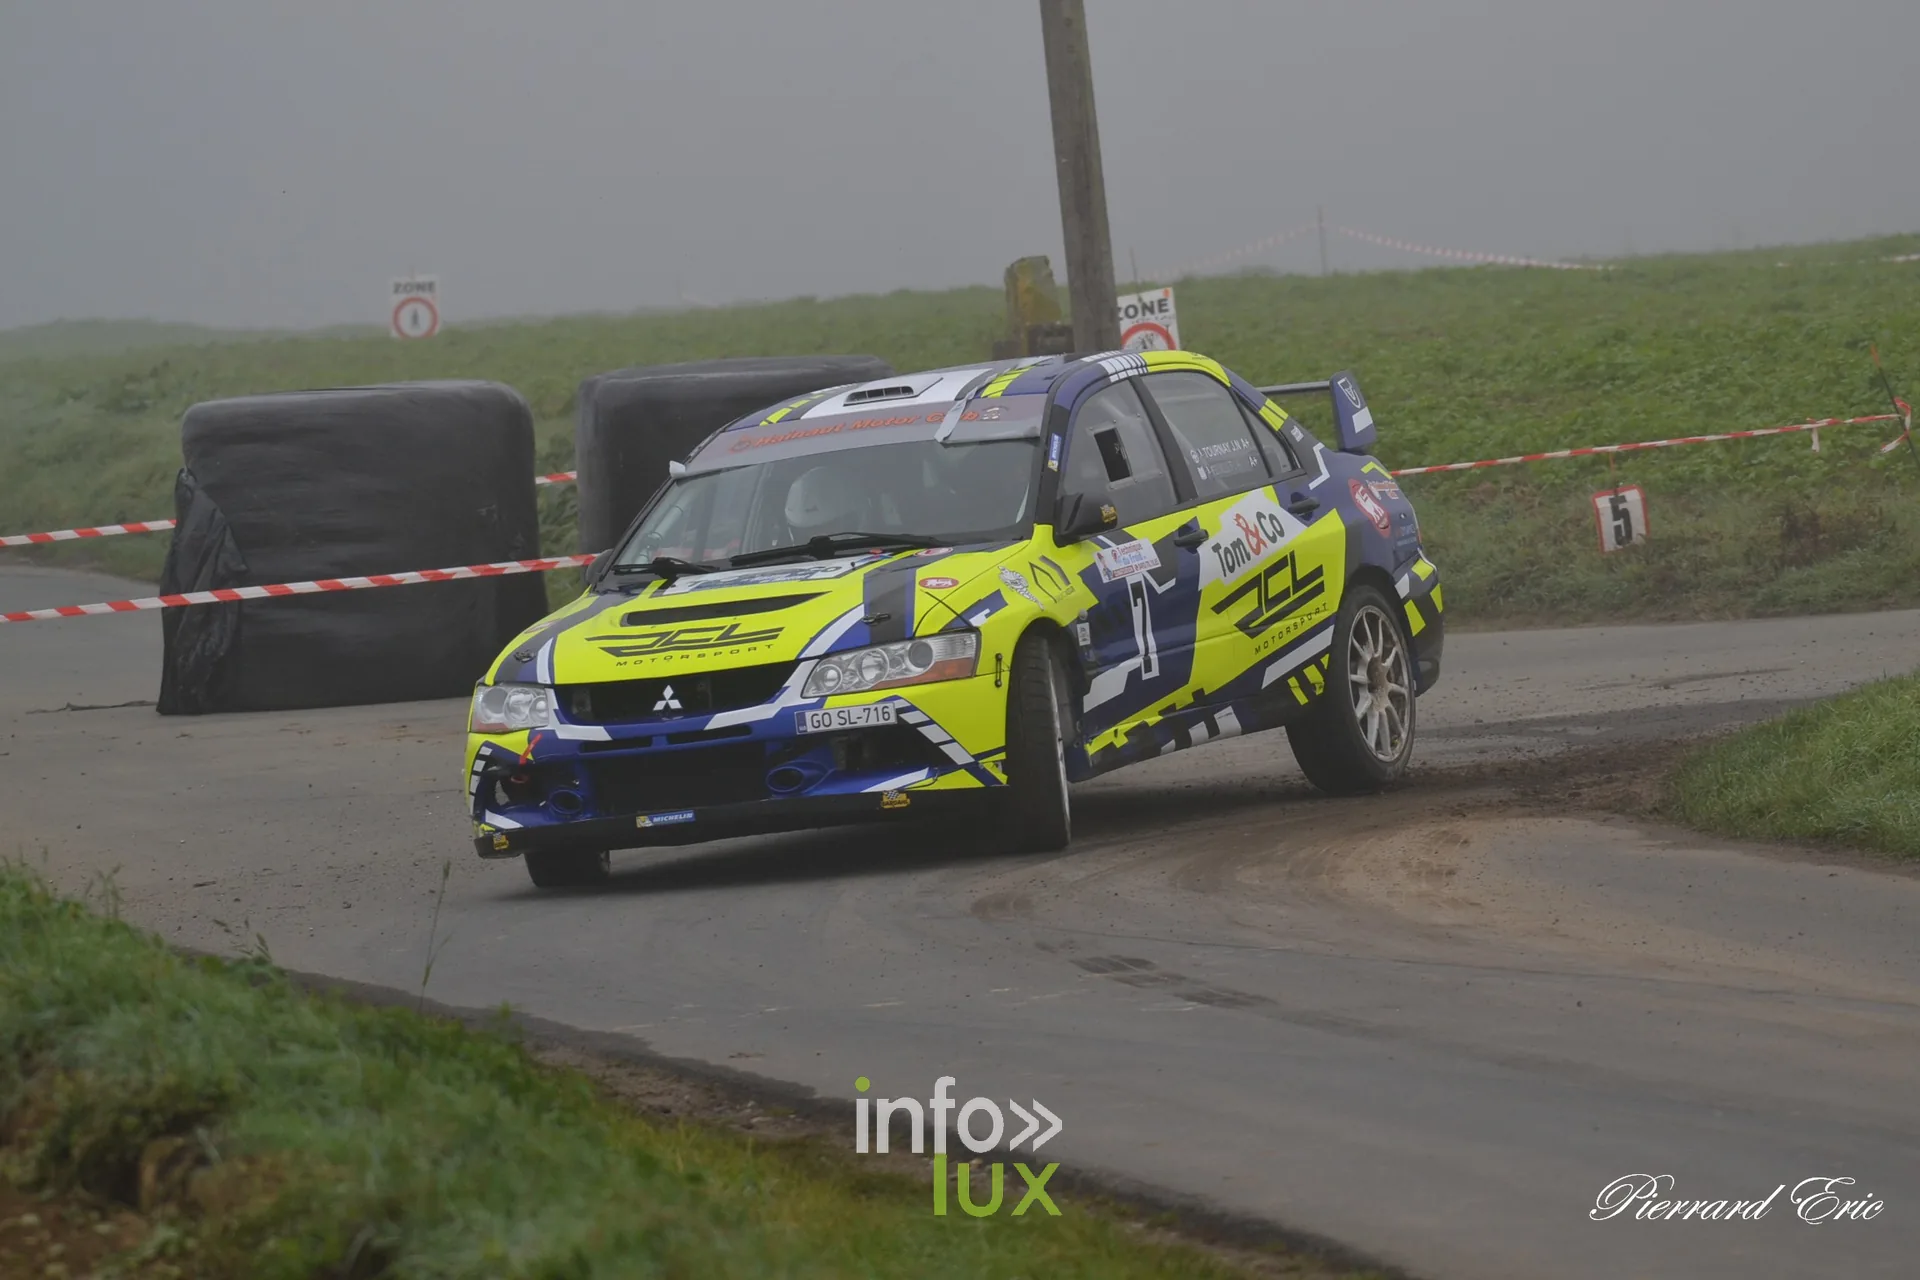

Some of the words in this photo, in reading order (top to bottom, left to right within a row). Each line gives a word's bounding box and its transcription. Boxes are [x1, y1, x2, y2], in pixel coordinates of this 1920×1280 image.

[393, 281, 436, 294] ZONE
[850, 414, 921, 430] Motor
[1608, 495, 1632, 546] 5
[1211, 511, 1285, 577] Tom&Co
[1128, 579, 1156, 677] 7
[1254, 602, 1328, 654] MOTORSPORT
[616, 644, 773, 667] MOTORSPORT
[811, 712, 832, 729] GO
[837, 706, 891, 726] SL-716
[652, 812, 694, 823] MICHELIN
